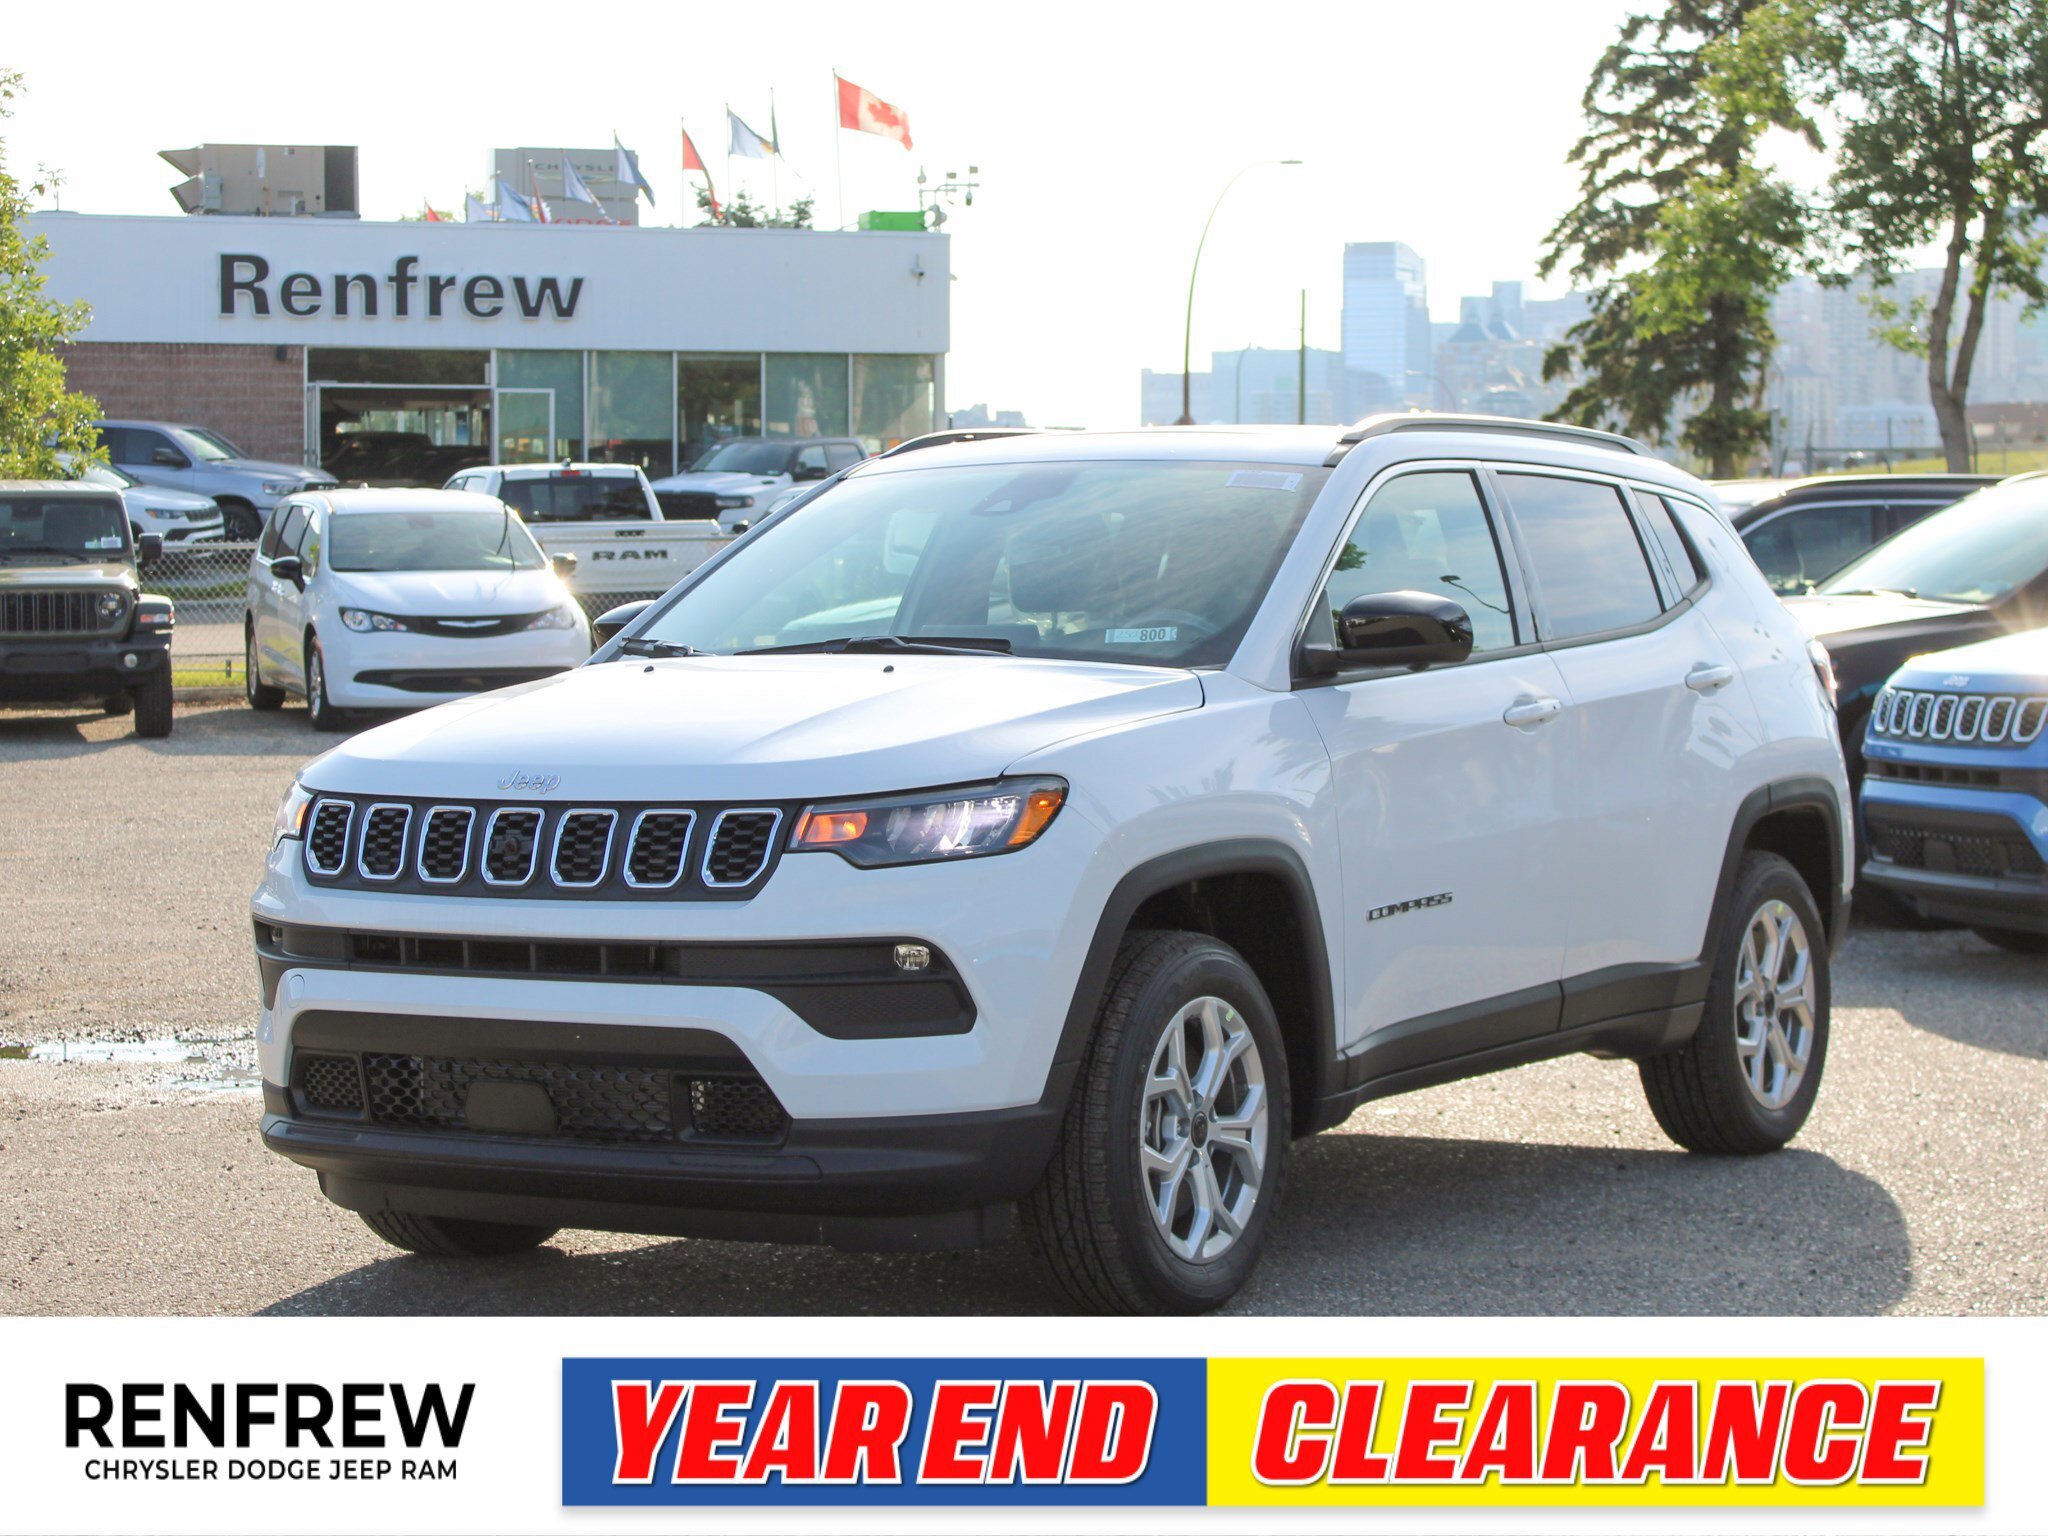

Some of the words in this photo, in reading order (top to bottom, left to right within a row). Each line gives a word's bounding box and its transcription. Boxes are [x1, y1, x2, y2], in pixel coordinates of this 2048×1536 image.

[219, 253, 584, 318] Renfrew
[592, 549, 668, 561] RAM
[1139, 628, 1166, 642] 800
[498, 769, 561, 795] Jeep
[1366, 891, 1453, 921] COMPASS
